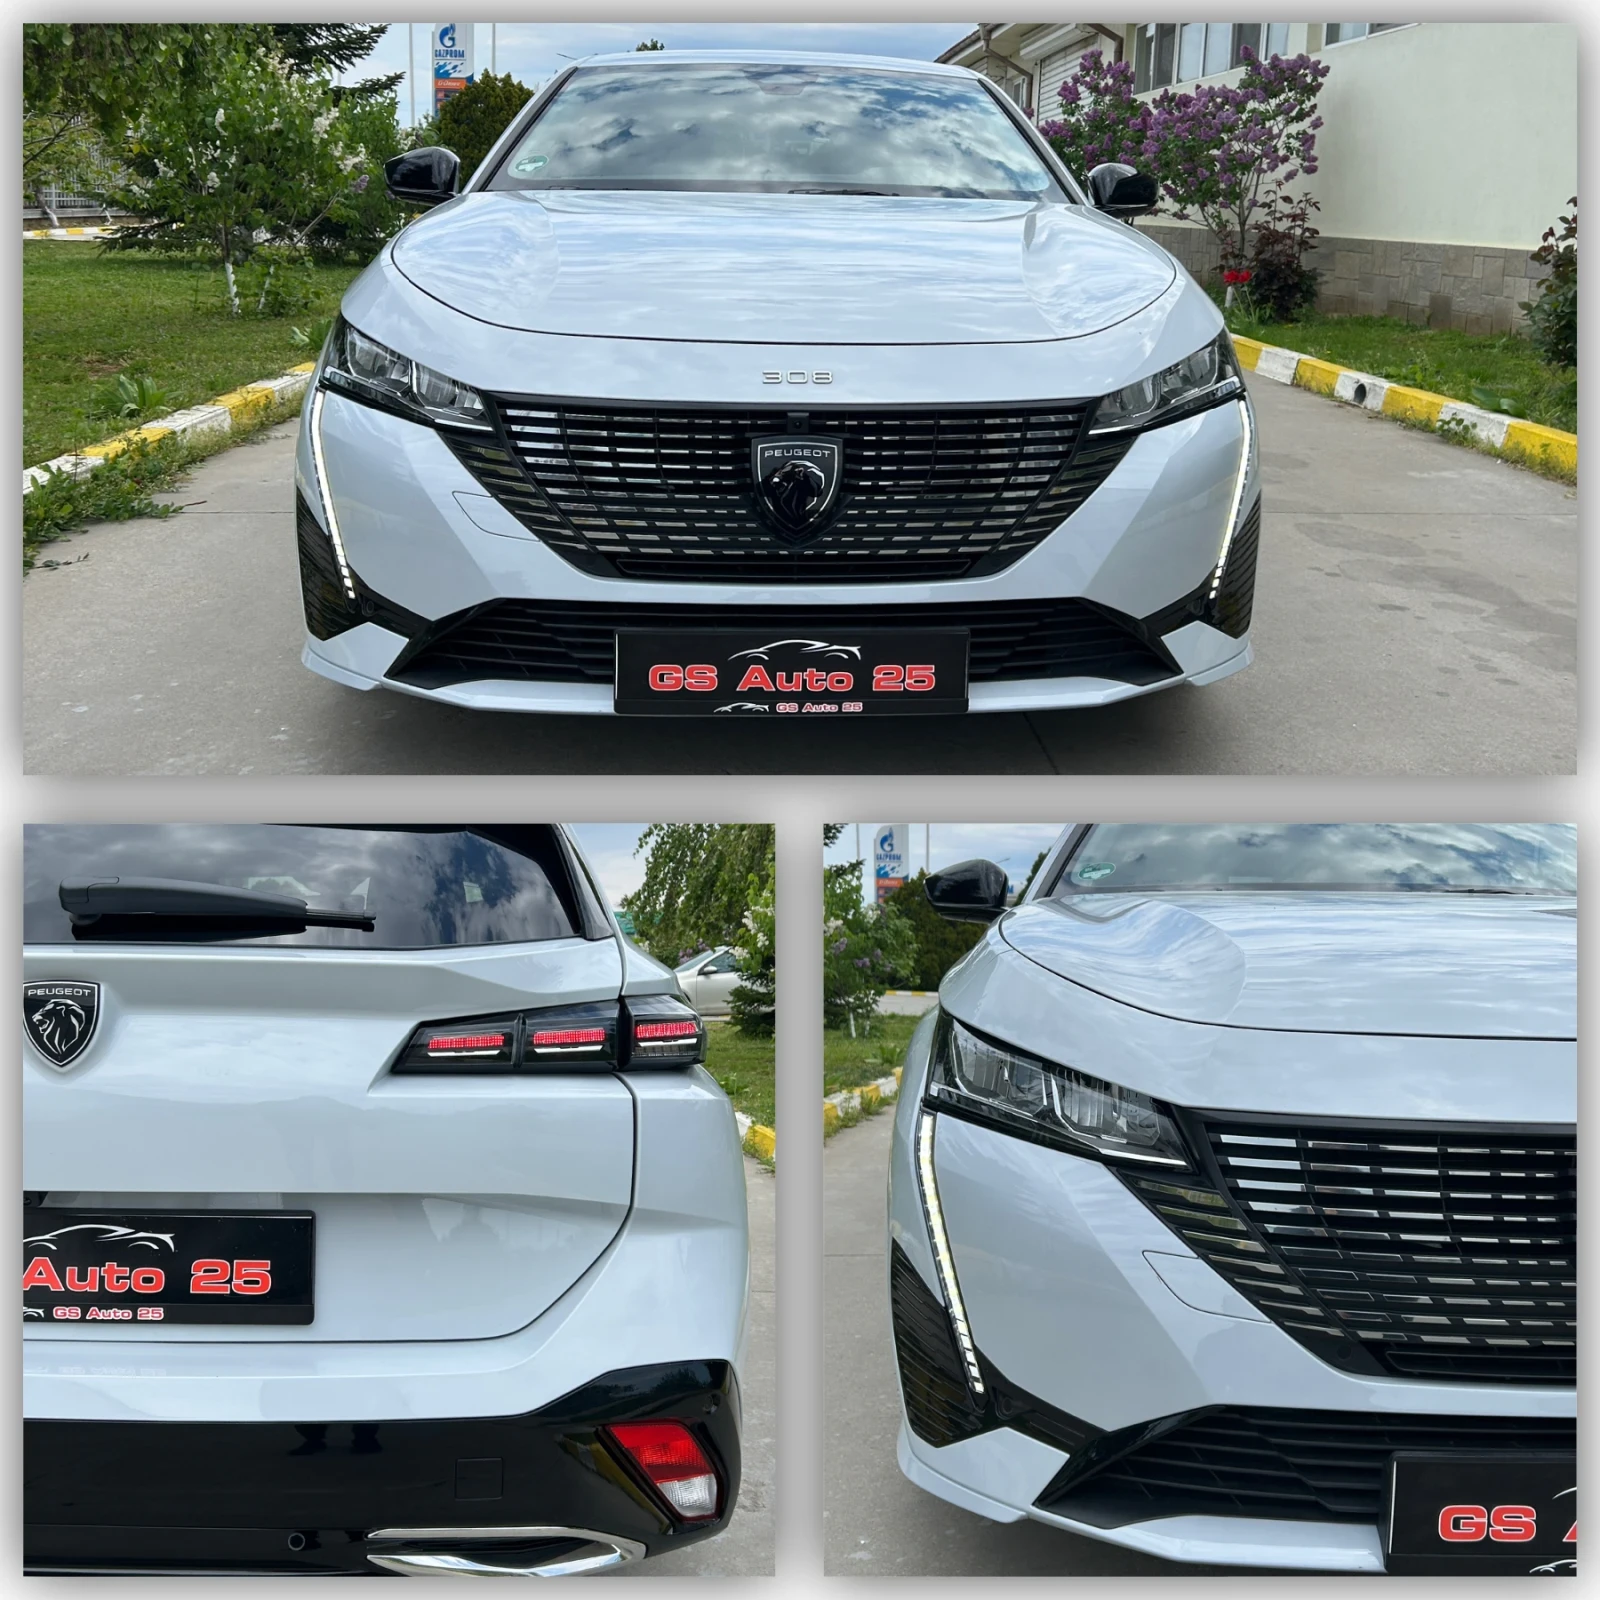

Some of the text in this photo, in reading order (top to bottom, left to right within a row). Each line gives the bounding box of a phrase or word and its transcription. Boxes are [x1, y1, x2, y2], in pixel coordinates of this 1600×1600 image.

[434, 49, 465, 58] GAZPROM
[762, 371, 832, 384] 308
[764, 449, 831, 458] PEUGEOT
[648, 664, 936, 692] GS Auto 25
[776, 702, 863, 713] GS Auto 25
[28, 987, 92, 996] PEUGEOT
[23, 1256, 272, 1295] Auto 25
[53, 1306, 164, 1321] GS Auto 25
[1438, 1505, 1536, 1542] GS
